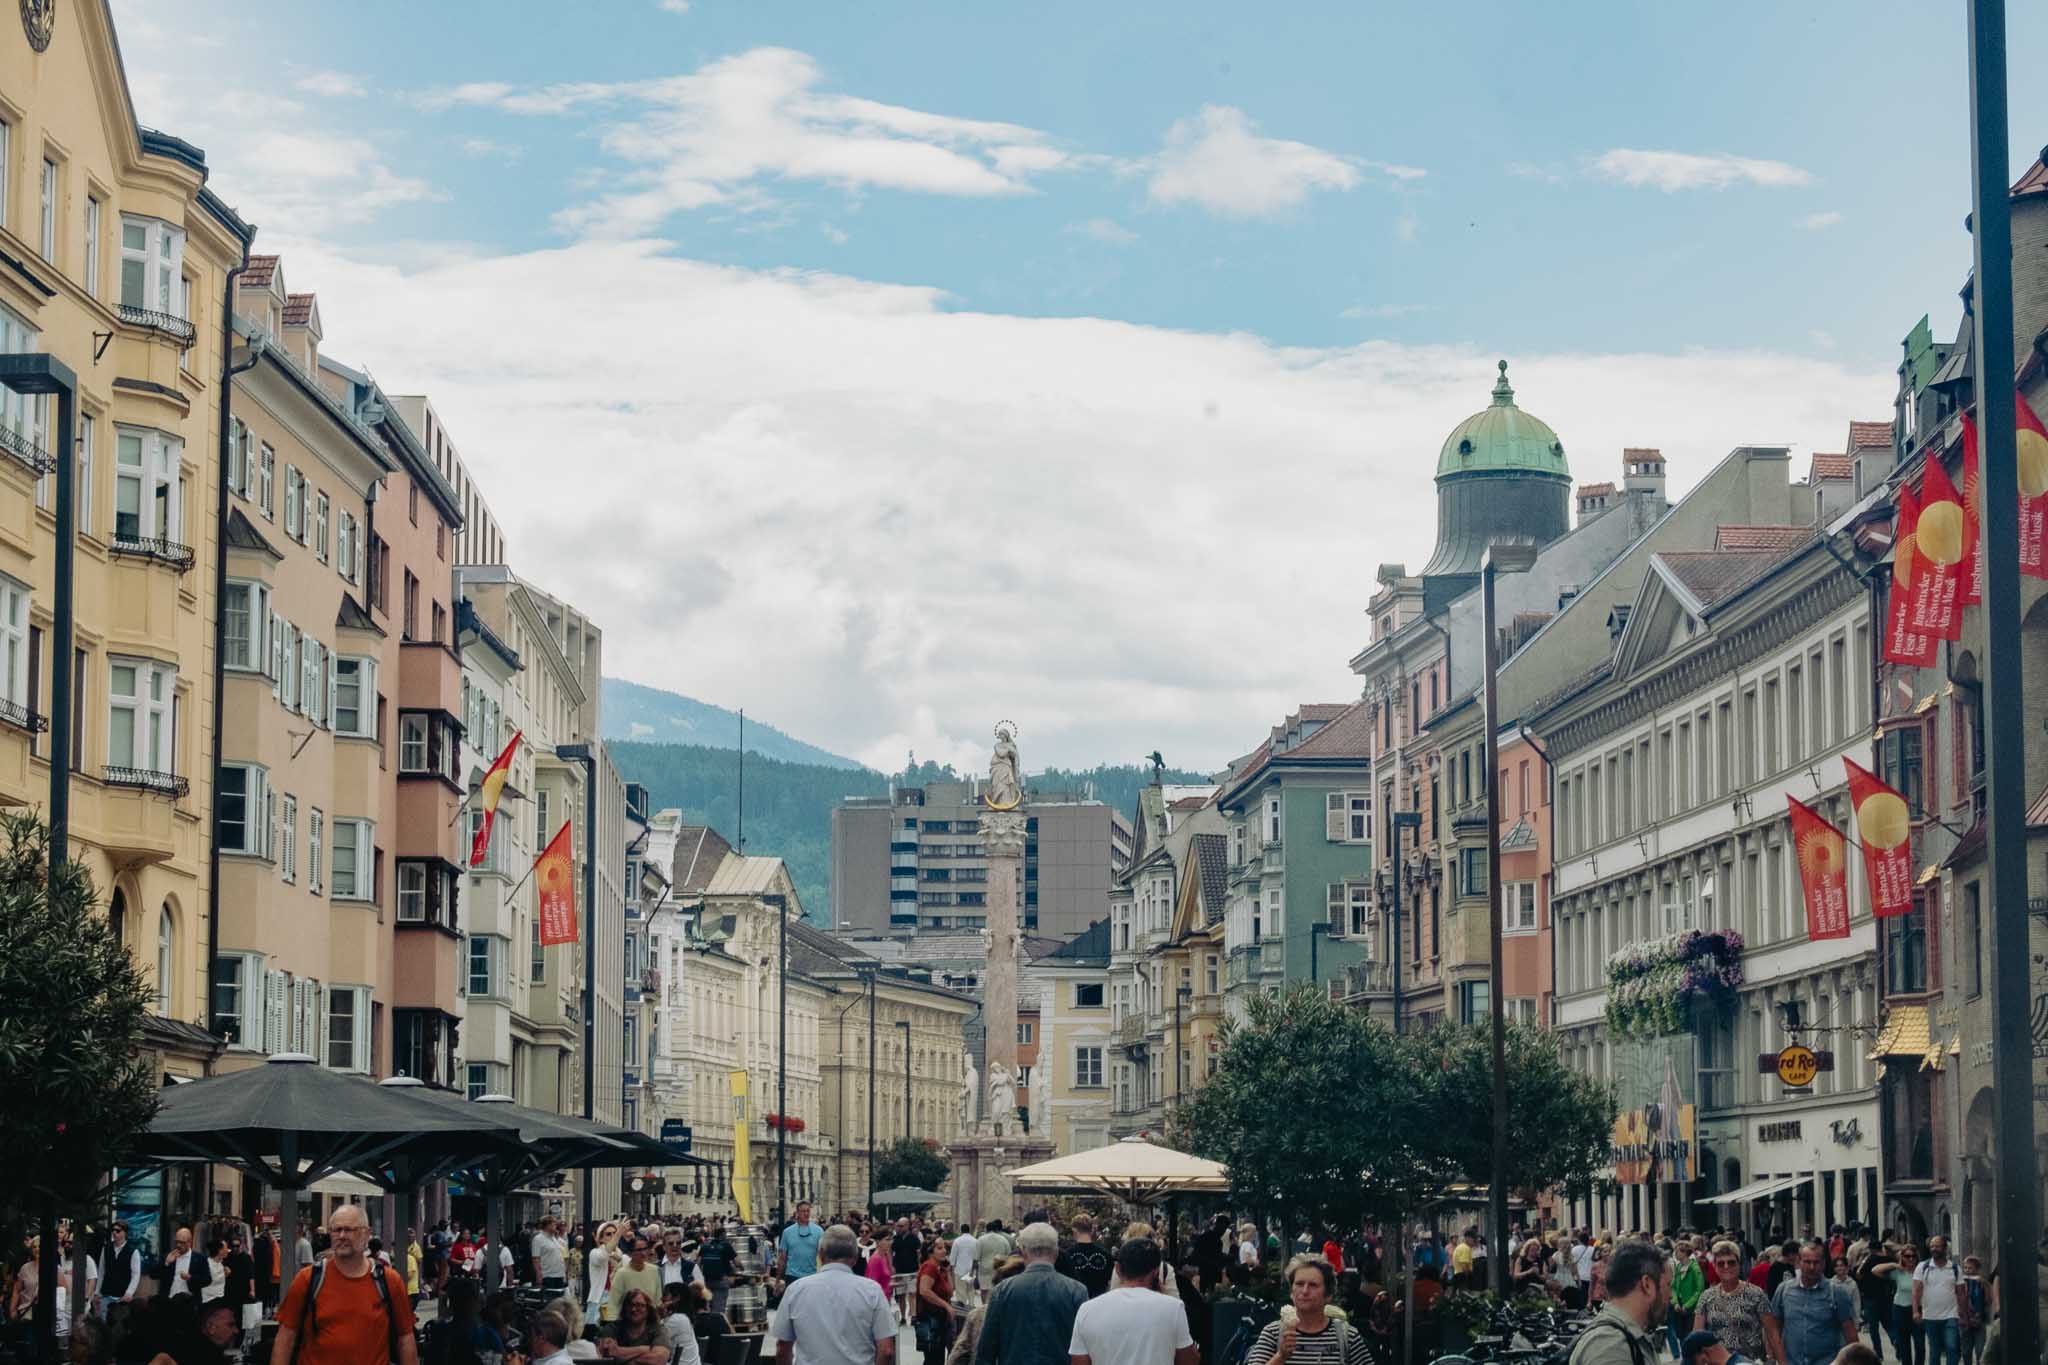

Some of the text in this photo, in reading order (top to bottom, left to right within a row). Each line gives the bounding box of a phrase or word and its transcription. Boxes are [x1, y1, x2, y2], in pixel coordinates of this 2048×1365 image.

[1912, 572, 1930, 626] Innsbrucker
[1925, 575, 1943, 628] Festwochen
[1938, 577, 1956, 629] Alten Musik
[1891, 601, 1907, 654] Innsbrucker
